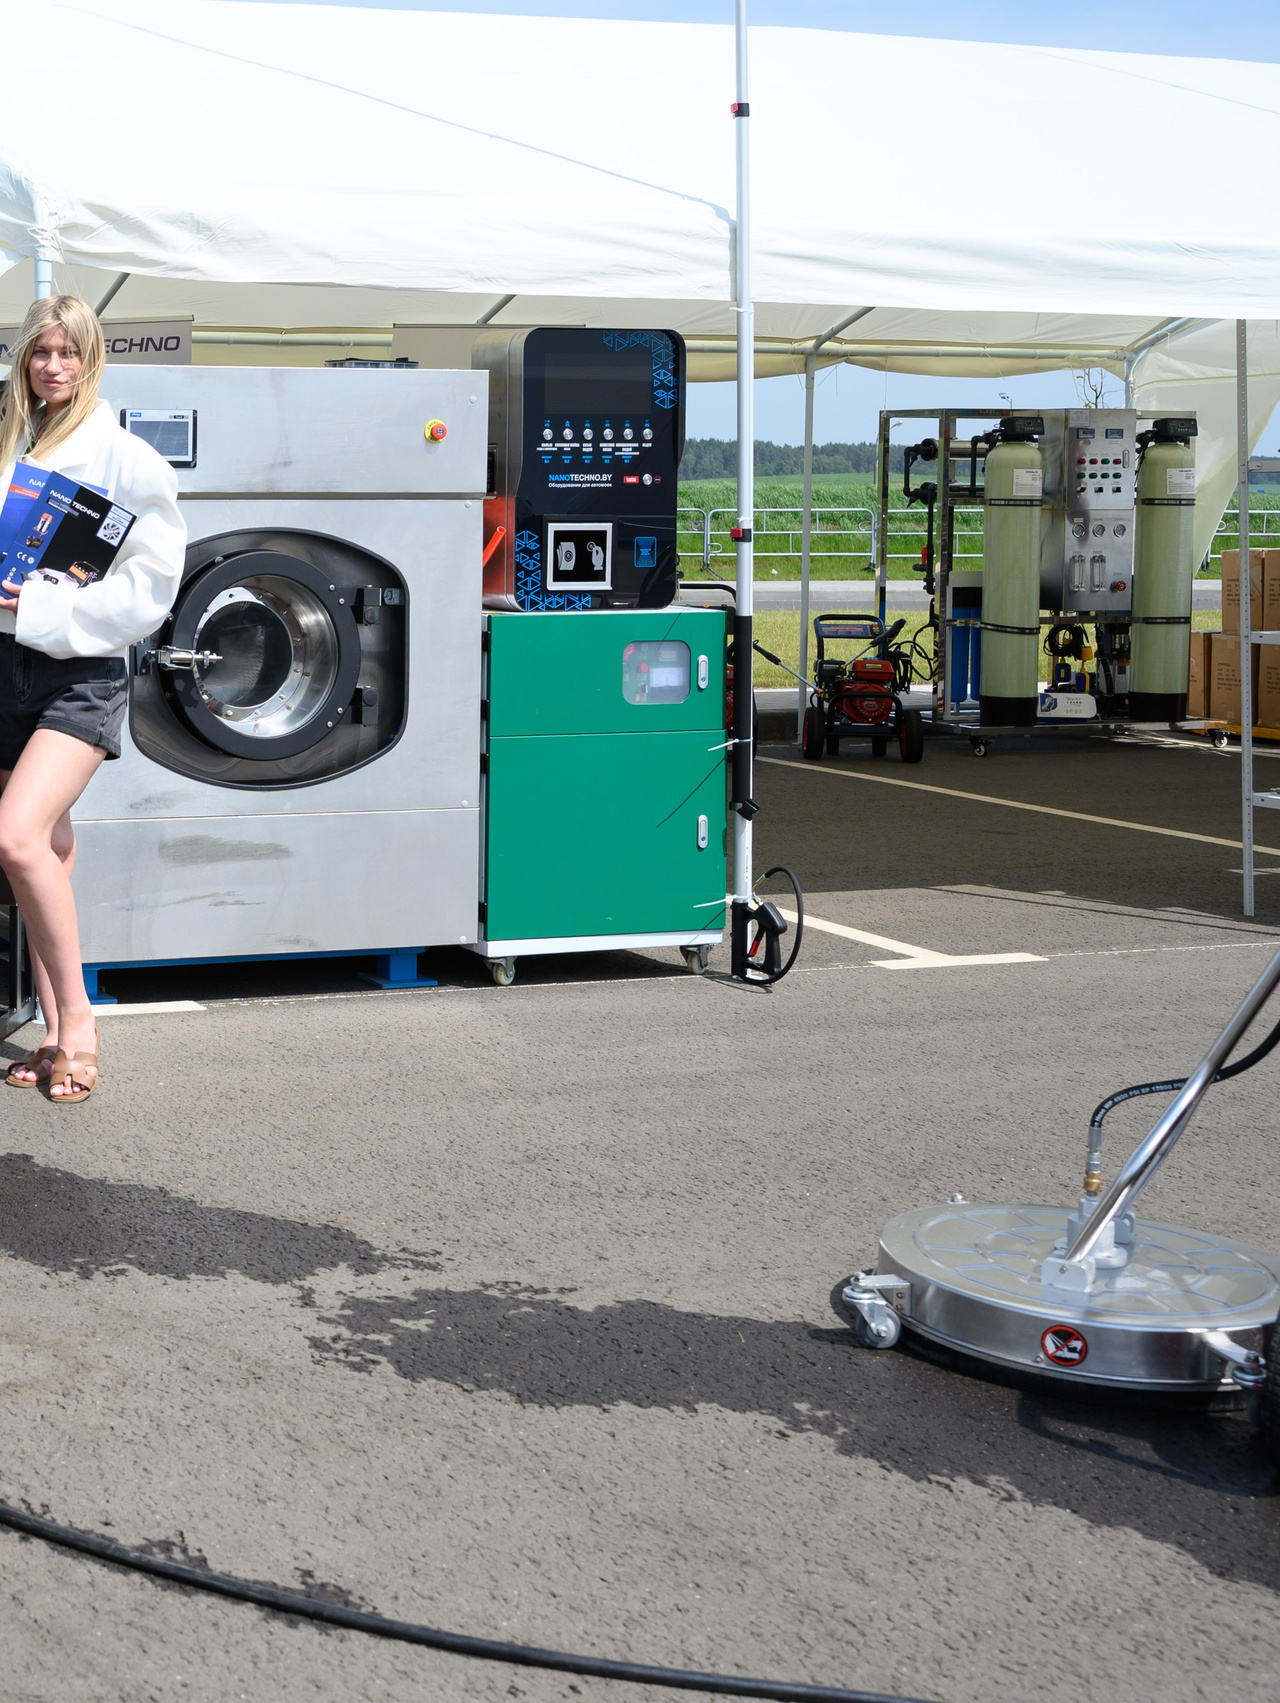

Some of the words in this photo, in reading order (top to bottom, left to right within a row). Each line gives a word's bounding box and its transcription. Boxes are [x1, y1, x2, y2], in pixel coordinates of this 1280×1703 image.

[548, 473, 613, 482] NANOTECHNO.BY
[49, 489, 72, 505] NANO
[72, 501, 101, 520] TECHNO
